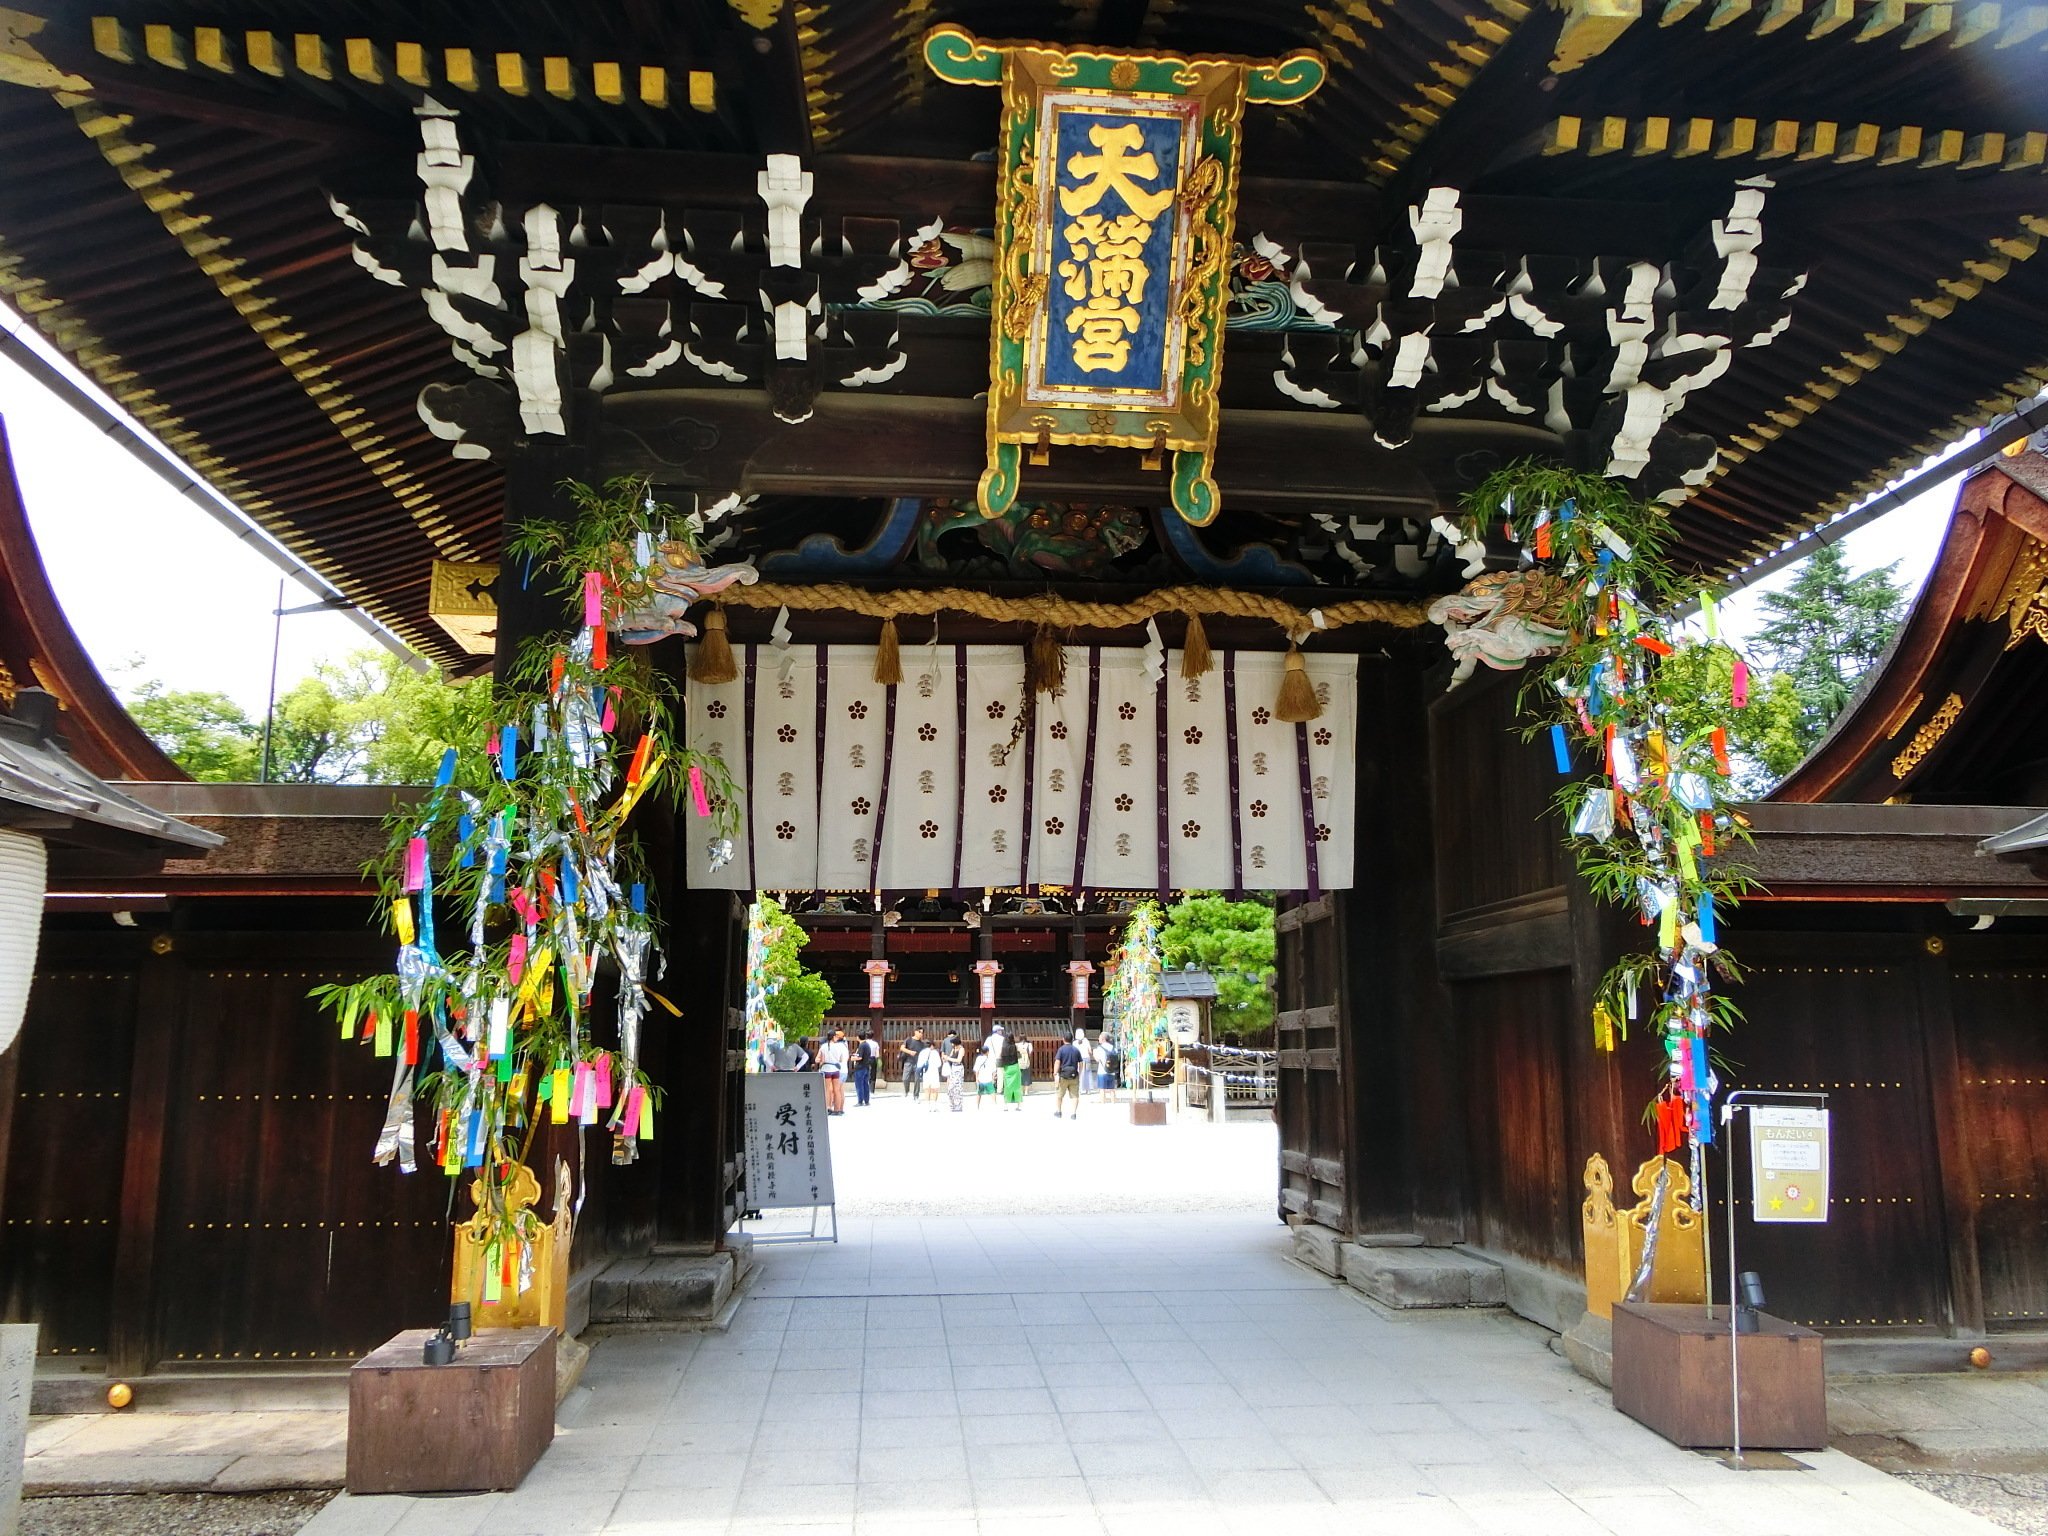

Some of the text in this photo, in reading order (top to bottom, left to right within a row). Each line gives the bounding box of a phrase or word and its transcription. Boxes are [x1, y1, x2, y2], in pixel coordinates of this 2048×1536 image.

[1058, 123, 1176, 373] 天満宮
[775, 1103, 799, 1155] 受付
